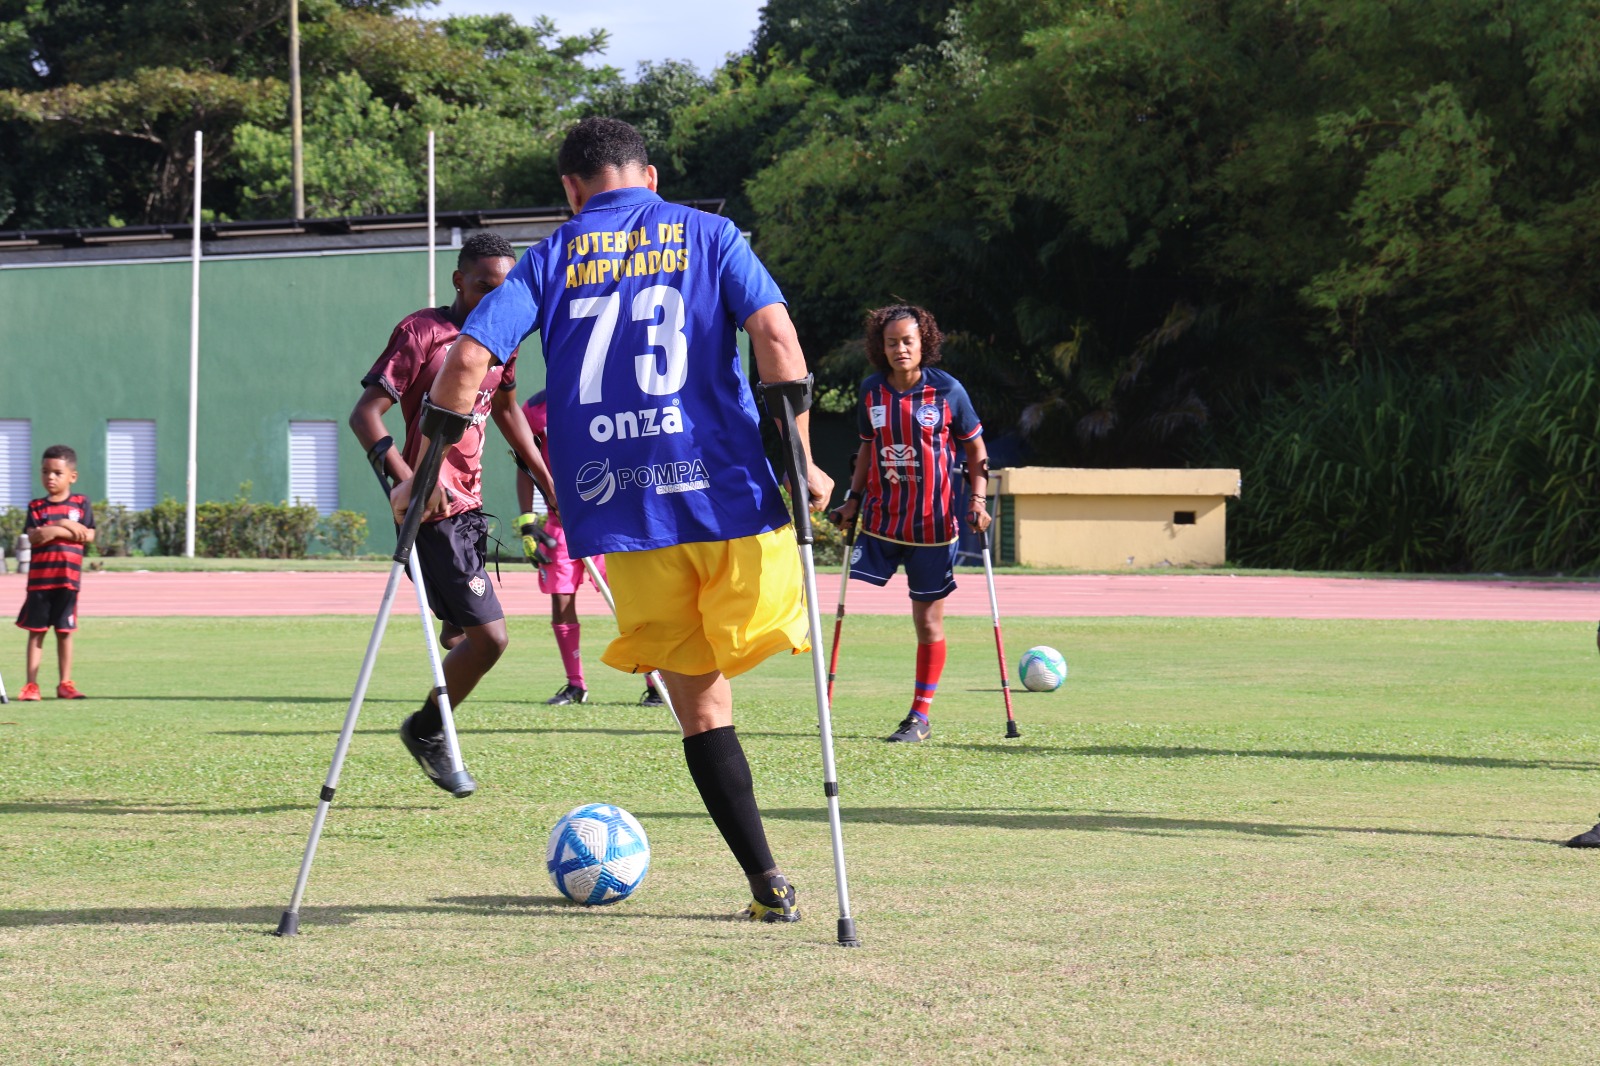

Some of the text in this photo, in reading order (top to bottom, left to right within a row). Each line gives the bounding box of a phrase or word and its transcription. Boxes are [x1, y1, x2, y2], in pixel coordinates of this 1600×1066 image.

[567, 223, 684, 260] FUTEBOL DE
[565, 248, 688, 289] AMPUTADOS
[569, 285, 689, 405] 73
[617, 458, 710, 489] POMPA
